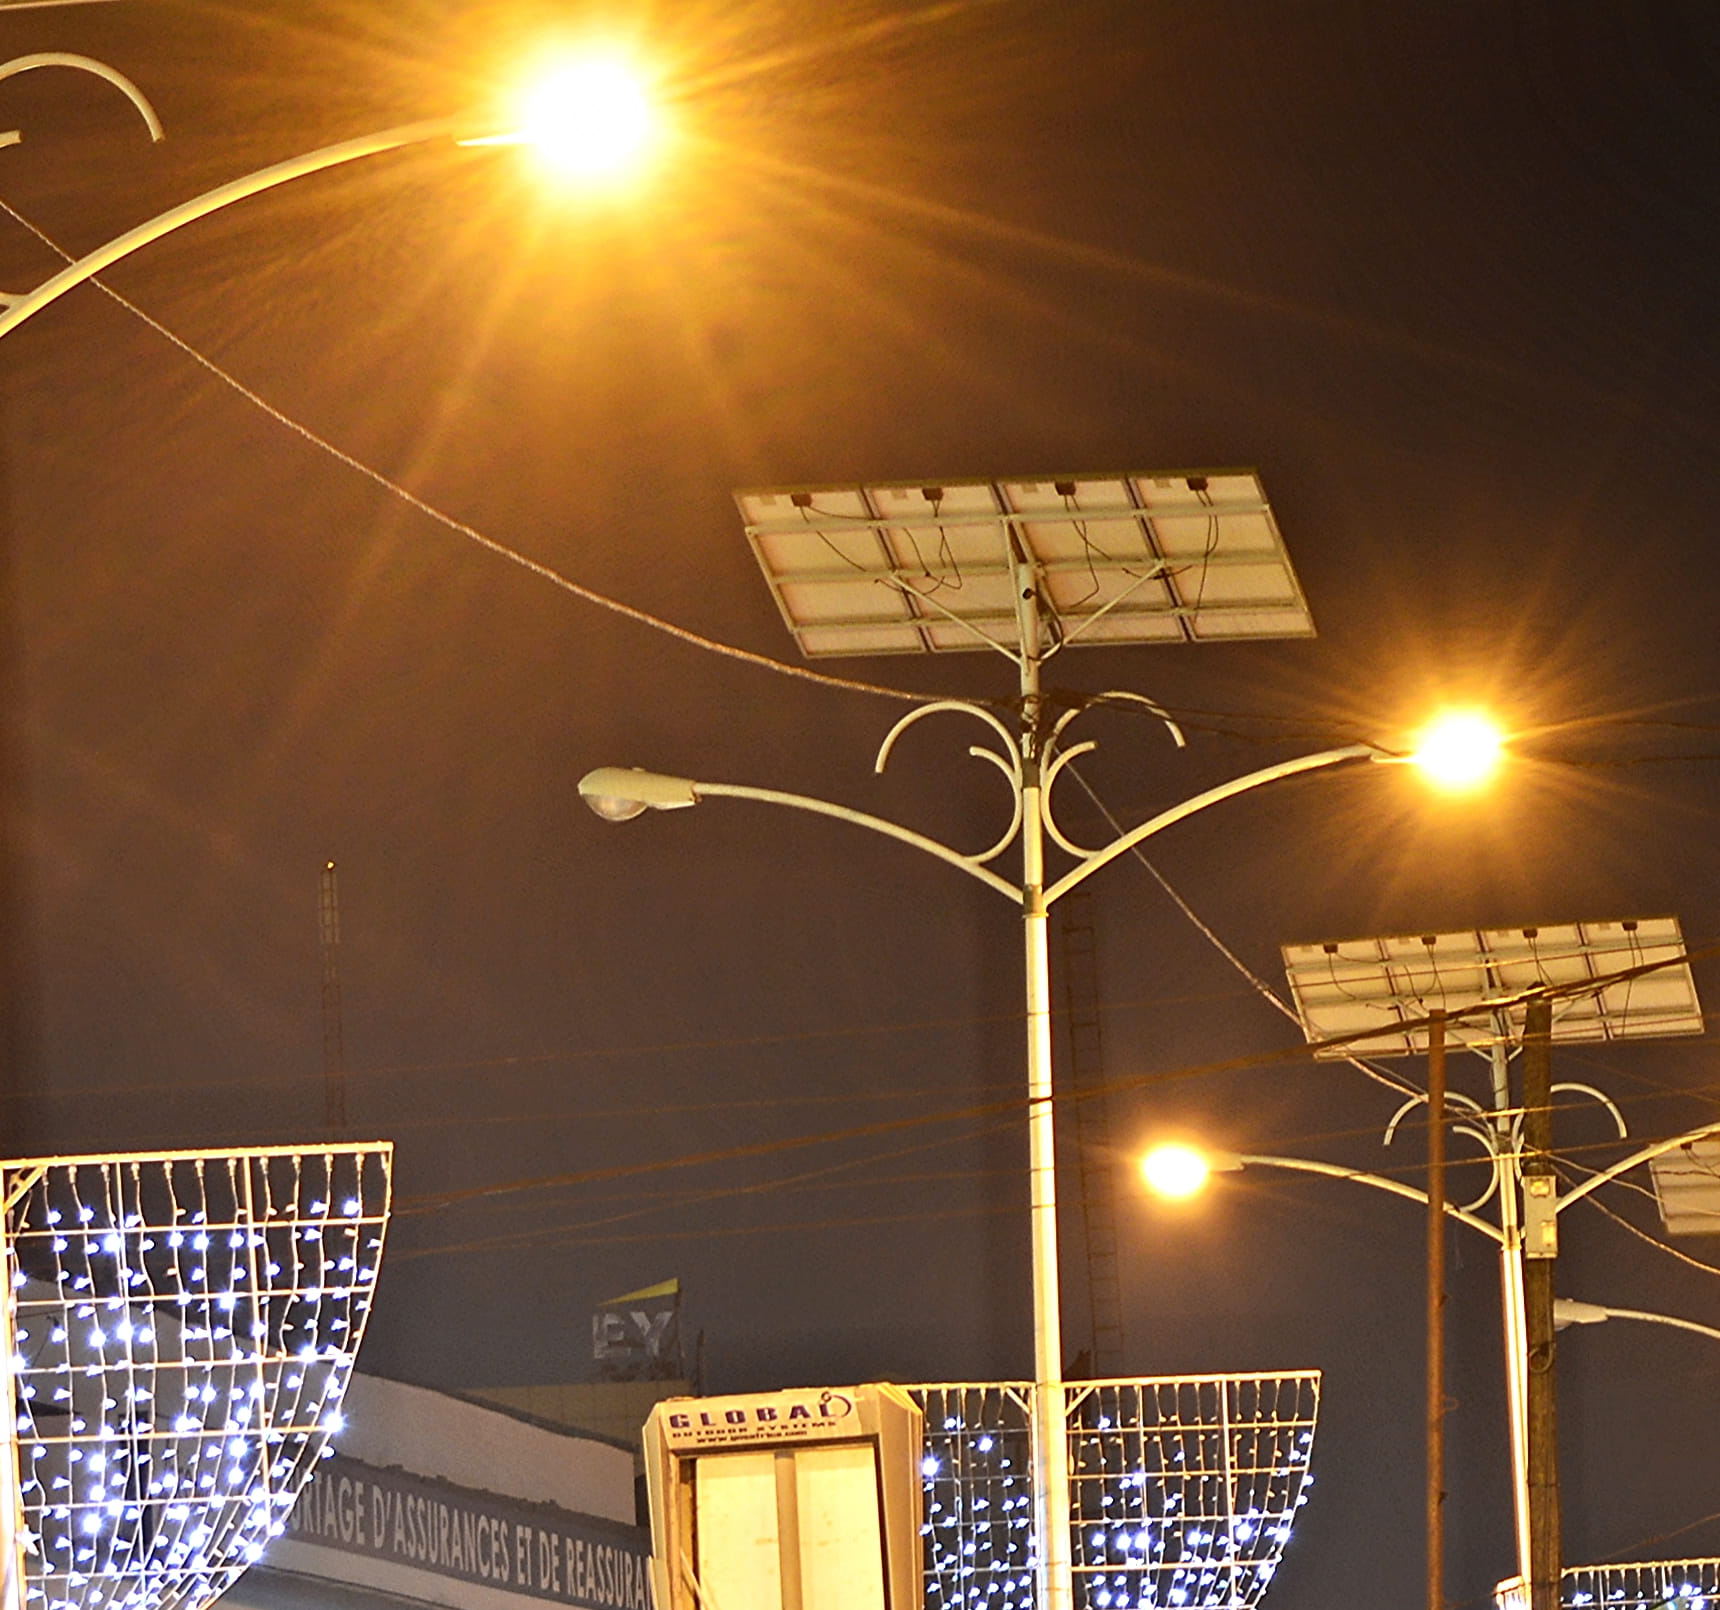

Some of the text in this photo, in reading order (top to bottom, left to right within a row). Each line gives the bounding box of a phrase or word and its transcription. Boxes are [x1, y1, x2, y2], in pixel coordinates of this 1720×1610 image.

[373, 1484, 511, 1582] D'ASSURANCES
[516, 1525, 534, 1587] ET
[539, 1530, 560, 1593] DE
